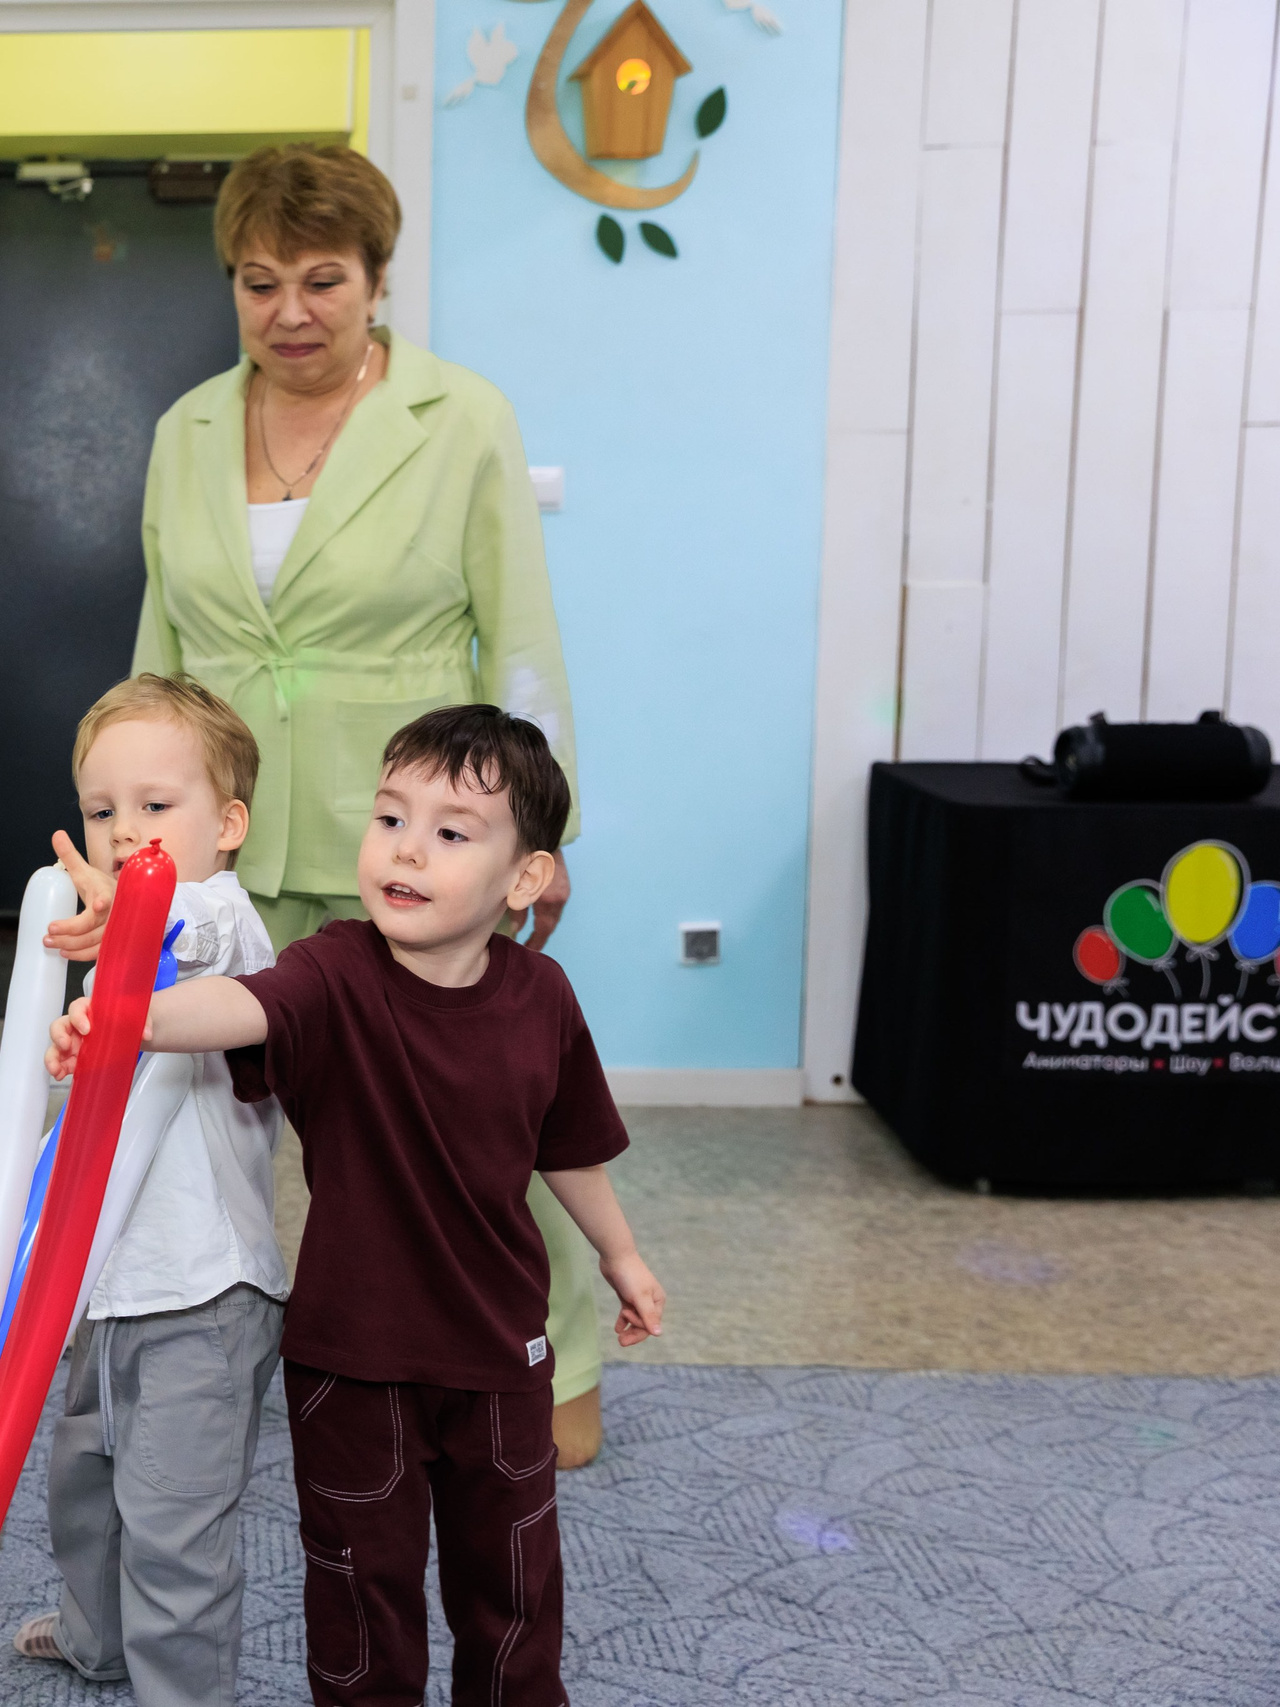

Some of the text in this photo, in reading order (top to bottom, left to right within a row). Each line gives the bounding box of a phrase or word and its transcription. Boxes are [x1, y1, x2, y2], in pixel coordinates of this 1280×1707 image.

[1016, 994, 1280, 1050] ЧУДОДЕЙС
[1022, 1051, 1149, 1074] Аниматоры
[1170, 1054, 1212, 1076] Шоу
